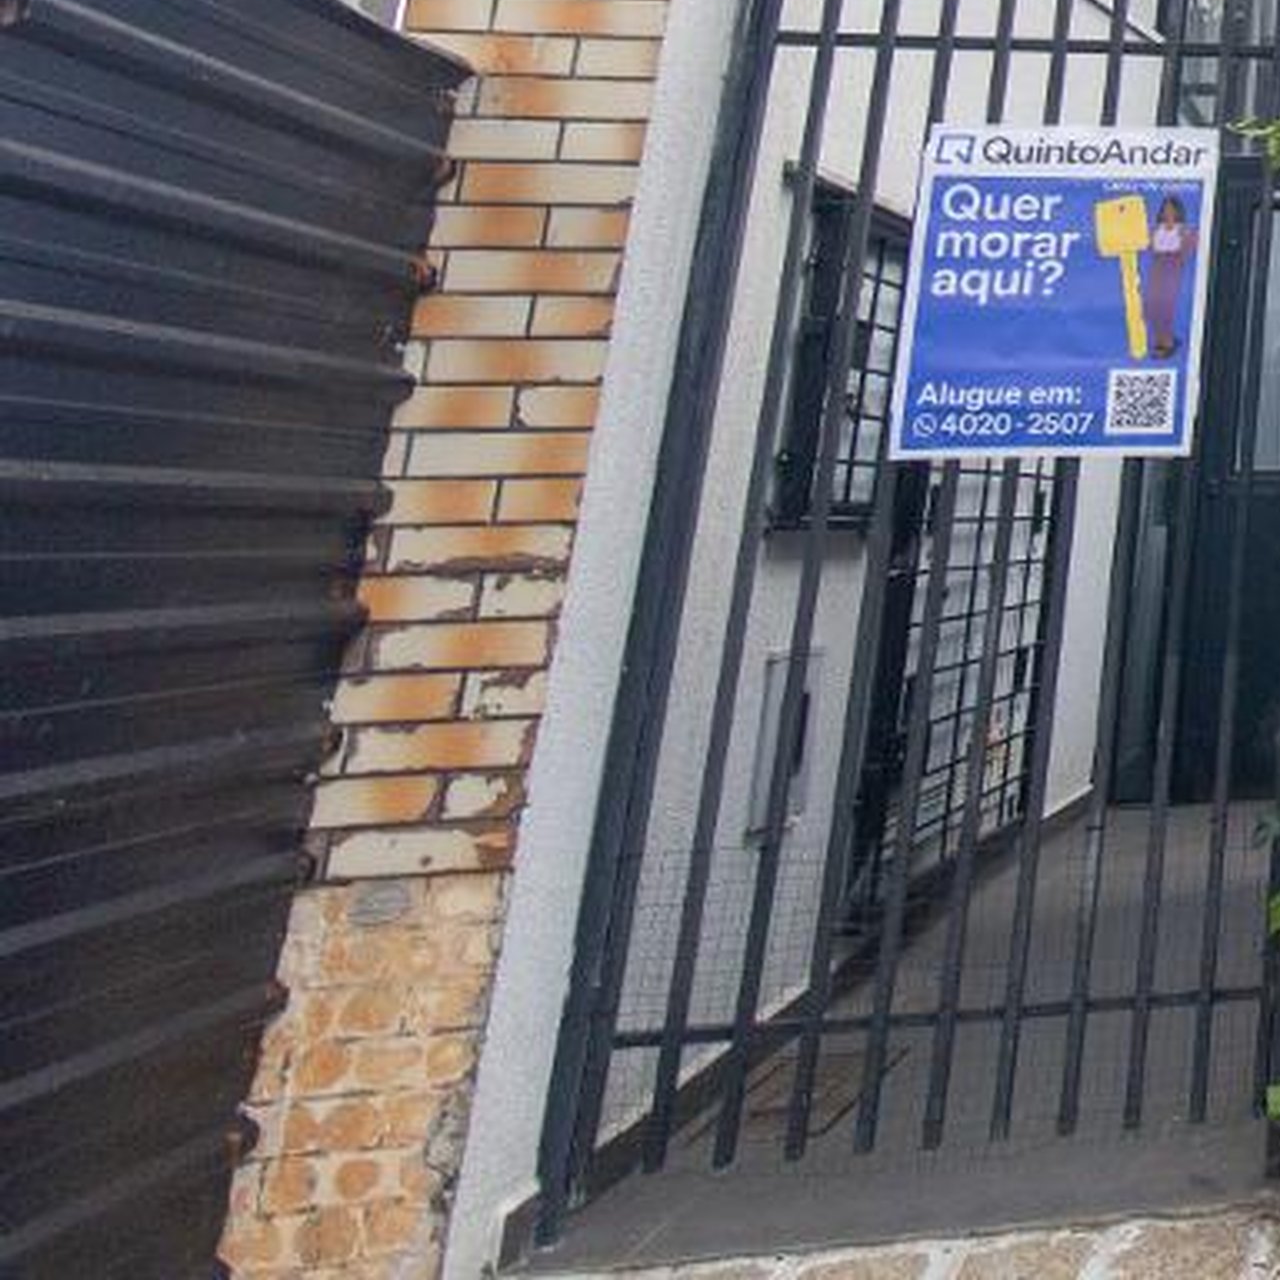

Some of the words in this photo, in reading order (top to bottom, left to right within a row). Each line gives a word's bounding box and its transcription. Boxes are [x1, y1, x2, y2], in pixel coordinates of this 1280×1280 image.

[981, 136, 1209, 167] QuintoAndar
[942, 183, 1063, 222] Quer
[935, 228, 1081, 260] morar
[930, 260, 1065, 306] aqui?
[916, 382, 1023, 411] Alugue
[1028, 385, 1083, 405] em:
